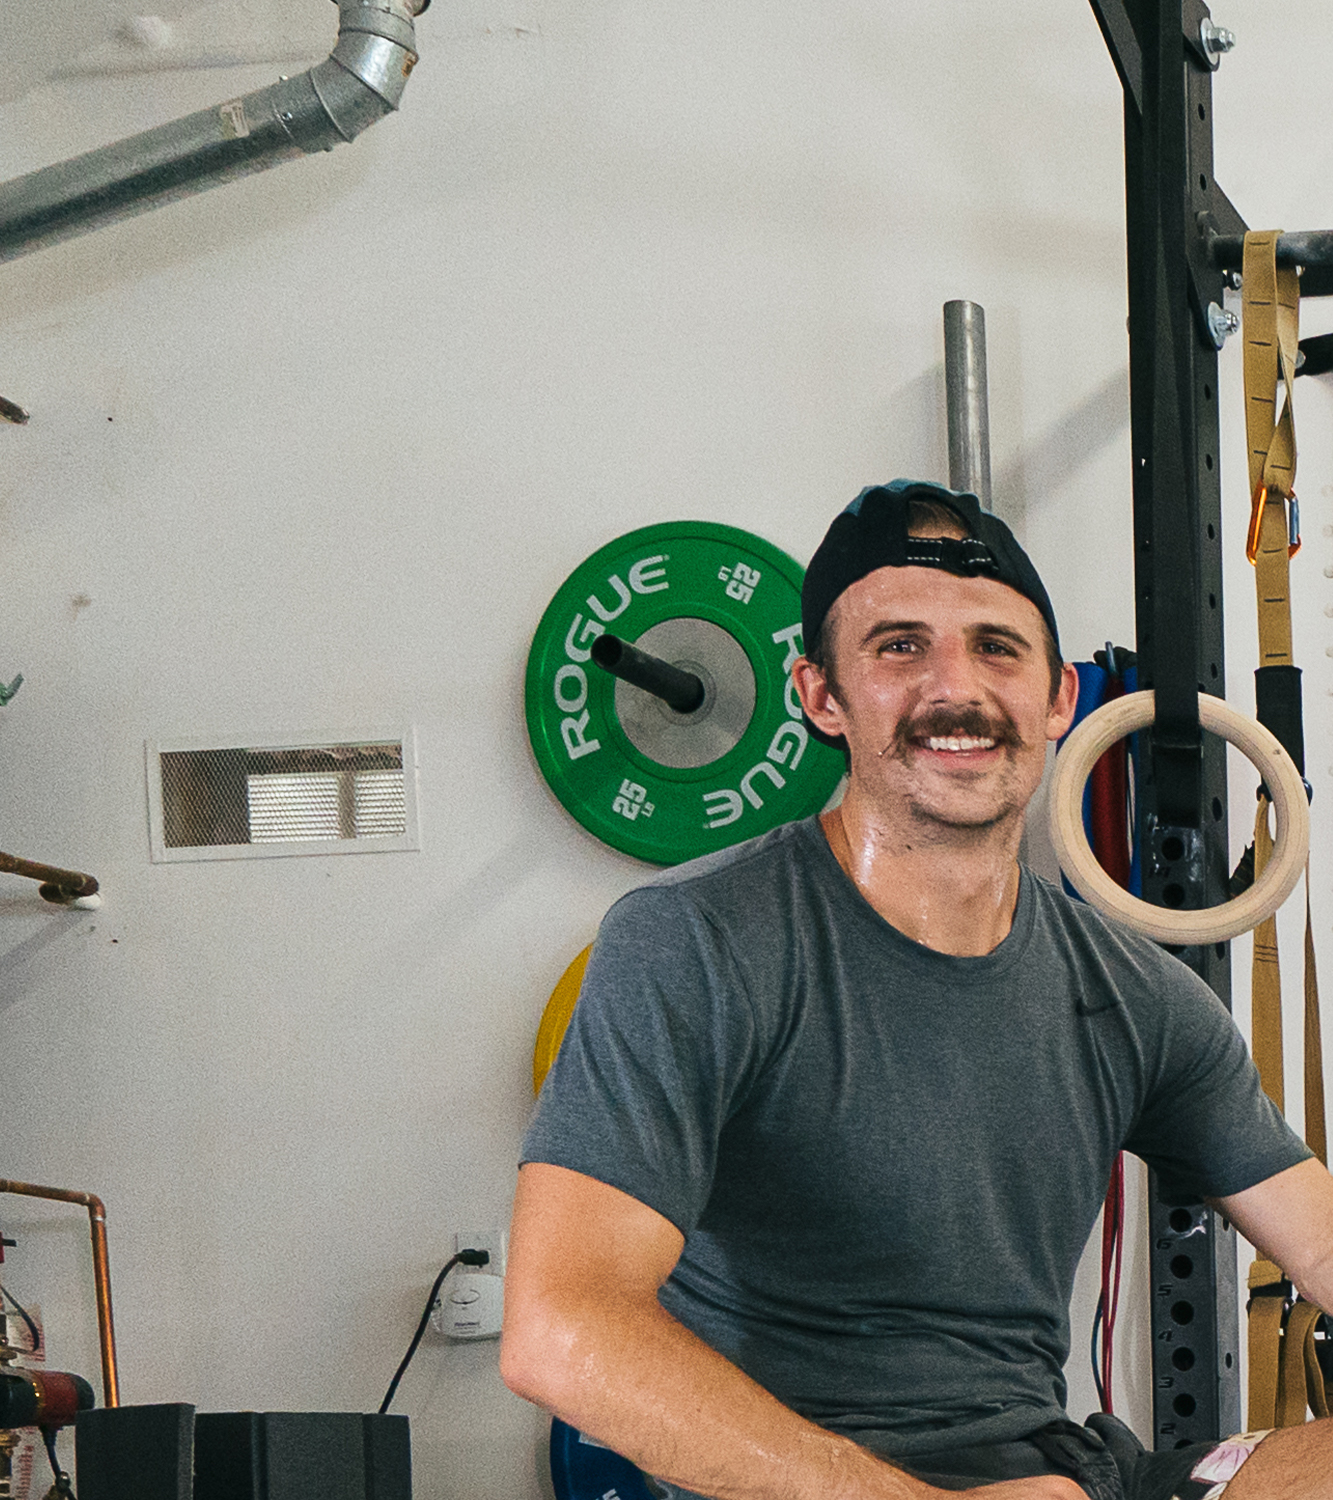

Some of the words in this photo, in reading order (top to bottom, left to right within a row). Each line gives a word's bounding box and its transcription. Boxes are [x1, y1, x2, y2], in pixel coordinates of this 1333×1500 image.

[725, 562, 761, 604] 25
[554, 555, 670, 760] ROGUE
[612, 779, 647, 821] 25
[1156, 1238, 1172, 1250] 6
[1157, 1284, 1173, 1297] 5
[1158, 1329, 1173, 1342] 4
[1159, 1376, 1174, 1389] 3
[1160, 1422, 1176, 1435] 2
